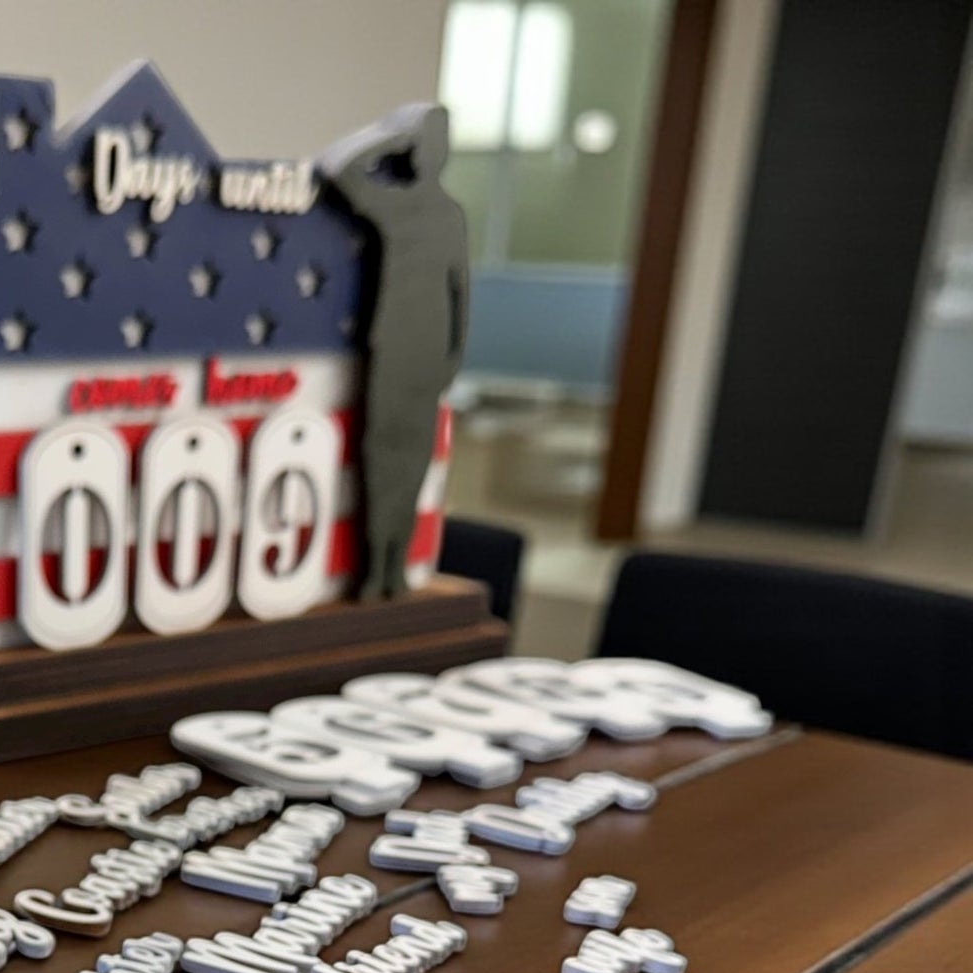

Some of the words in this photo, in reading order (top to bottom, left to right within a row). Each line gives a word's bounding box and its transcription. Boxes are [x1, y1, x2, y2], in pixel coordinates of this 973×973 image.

[92, 128, 202, 222] Days
[219, 158, 319, 216] until
[69, 373, 178, 415] comes
[204, 353, 298, 407] home
